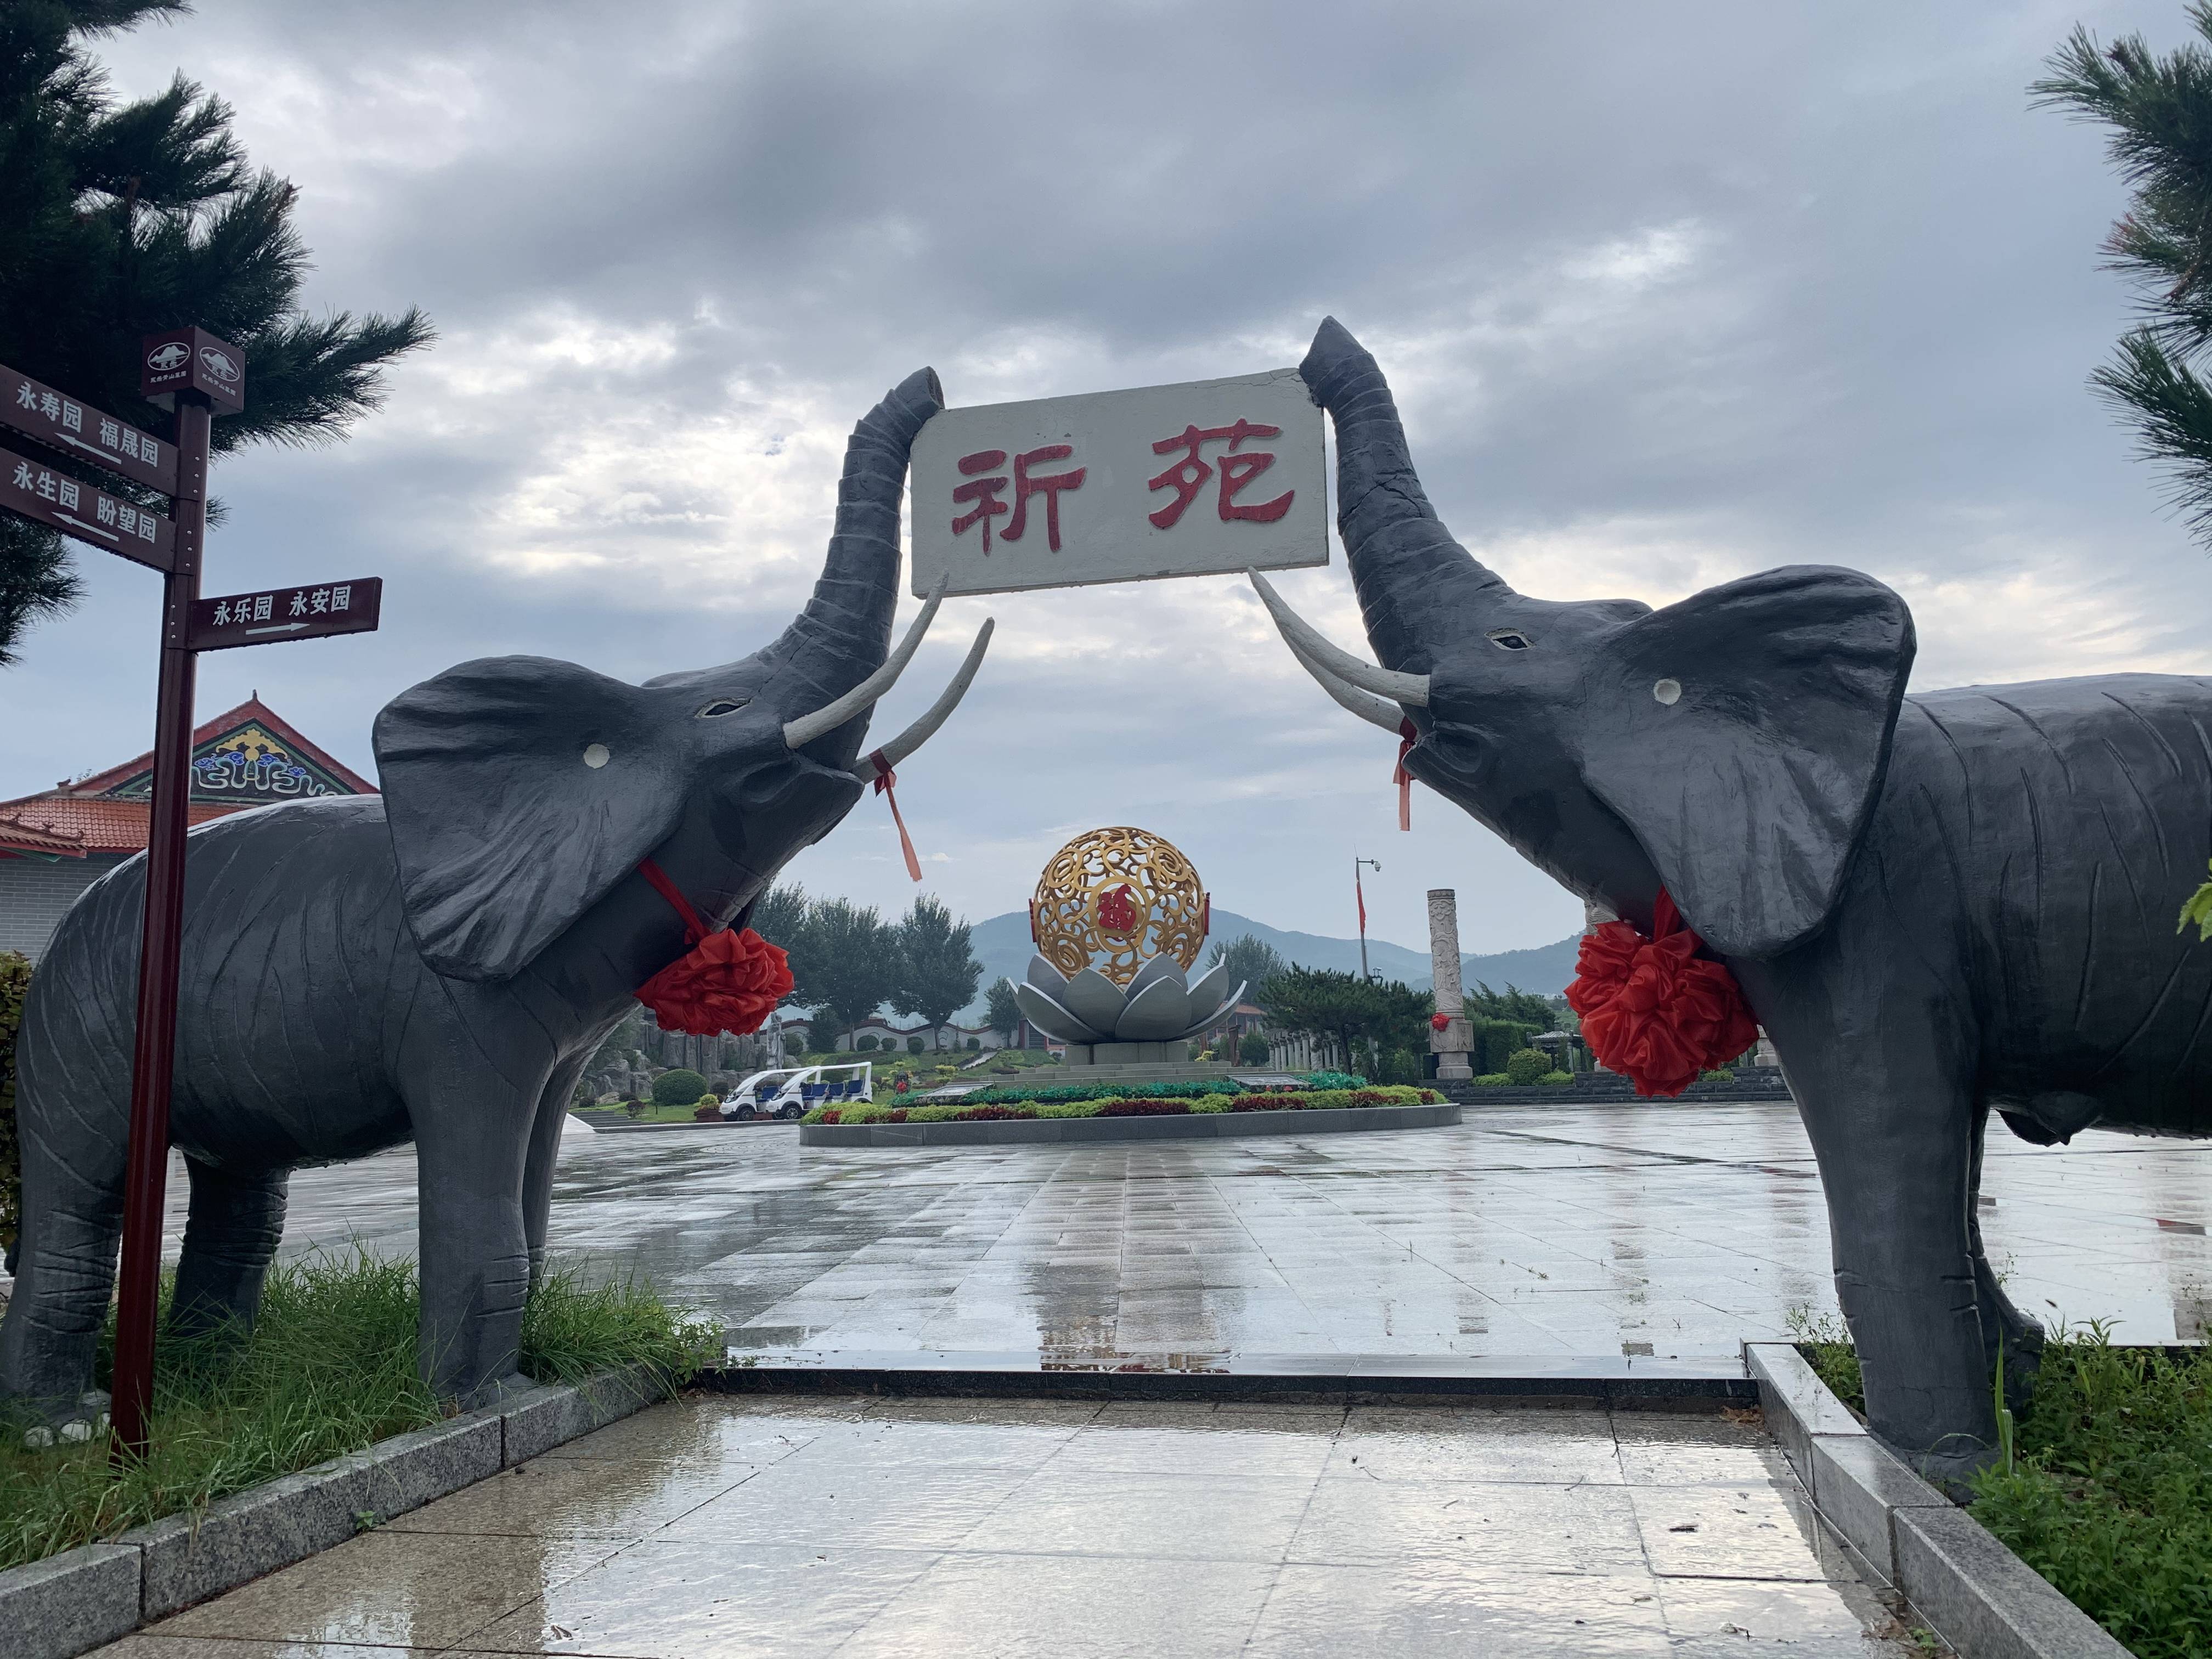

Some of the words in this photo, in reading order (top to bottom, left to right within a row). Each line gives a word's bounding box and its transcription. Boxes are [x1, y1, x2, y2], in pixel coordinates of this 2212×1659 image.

[16, 381, 82, 433] 永寿园
[99, 417, 158, 467] 福晟园
[13, 461, 79, 511] 永生园
[97, 495, 156, 544] 盼望园
[952, 418, 1295, 556] 祈苑
[213, 595, 273, 625] 永乐园
[289, 585, 351, 617] 永安园
